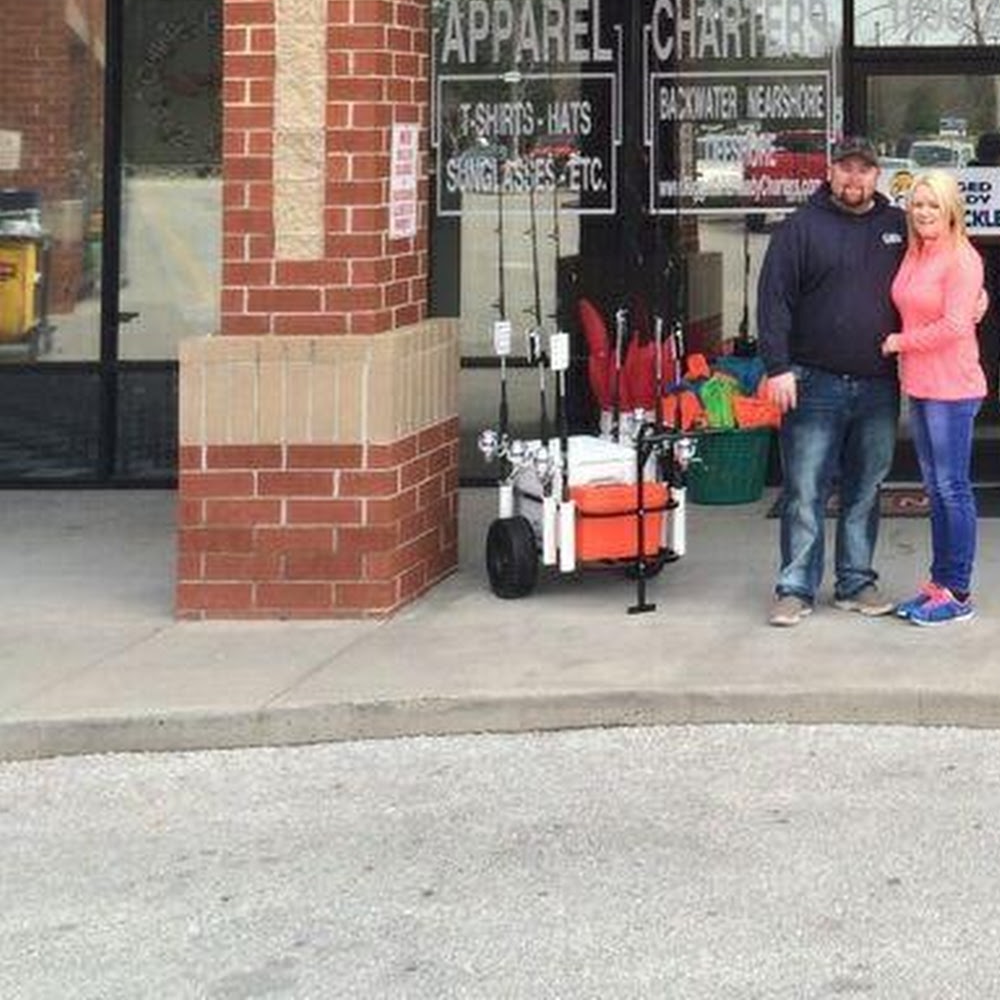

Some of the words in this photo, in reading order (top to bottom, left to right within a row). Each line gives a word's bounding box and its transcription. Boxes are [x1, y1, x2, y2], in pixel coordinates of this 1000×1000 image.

[459, 102, 535, 136] T-SHIRTS
[547, 101, 592, 135] HATS
[446, 153, 557, 191] SUNGLASSES
[570, 154, 608, 191] ETC.
